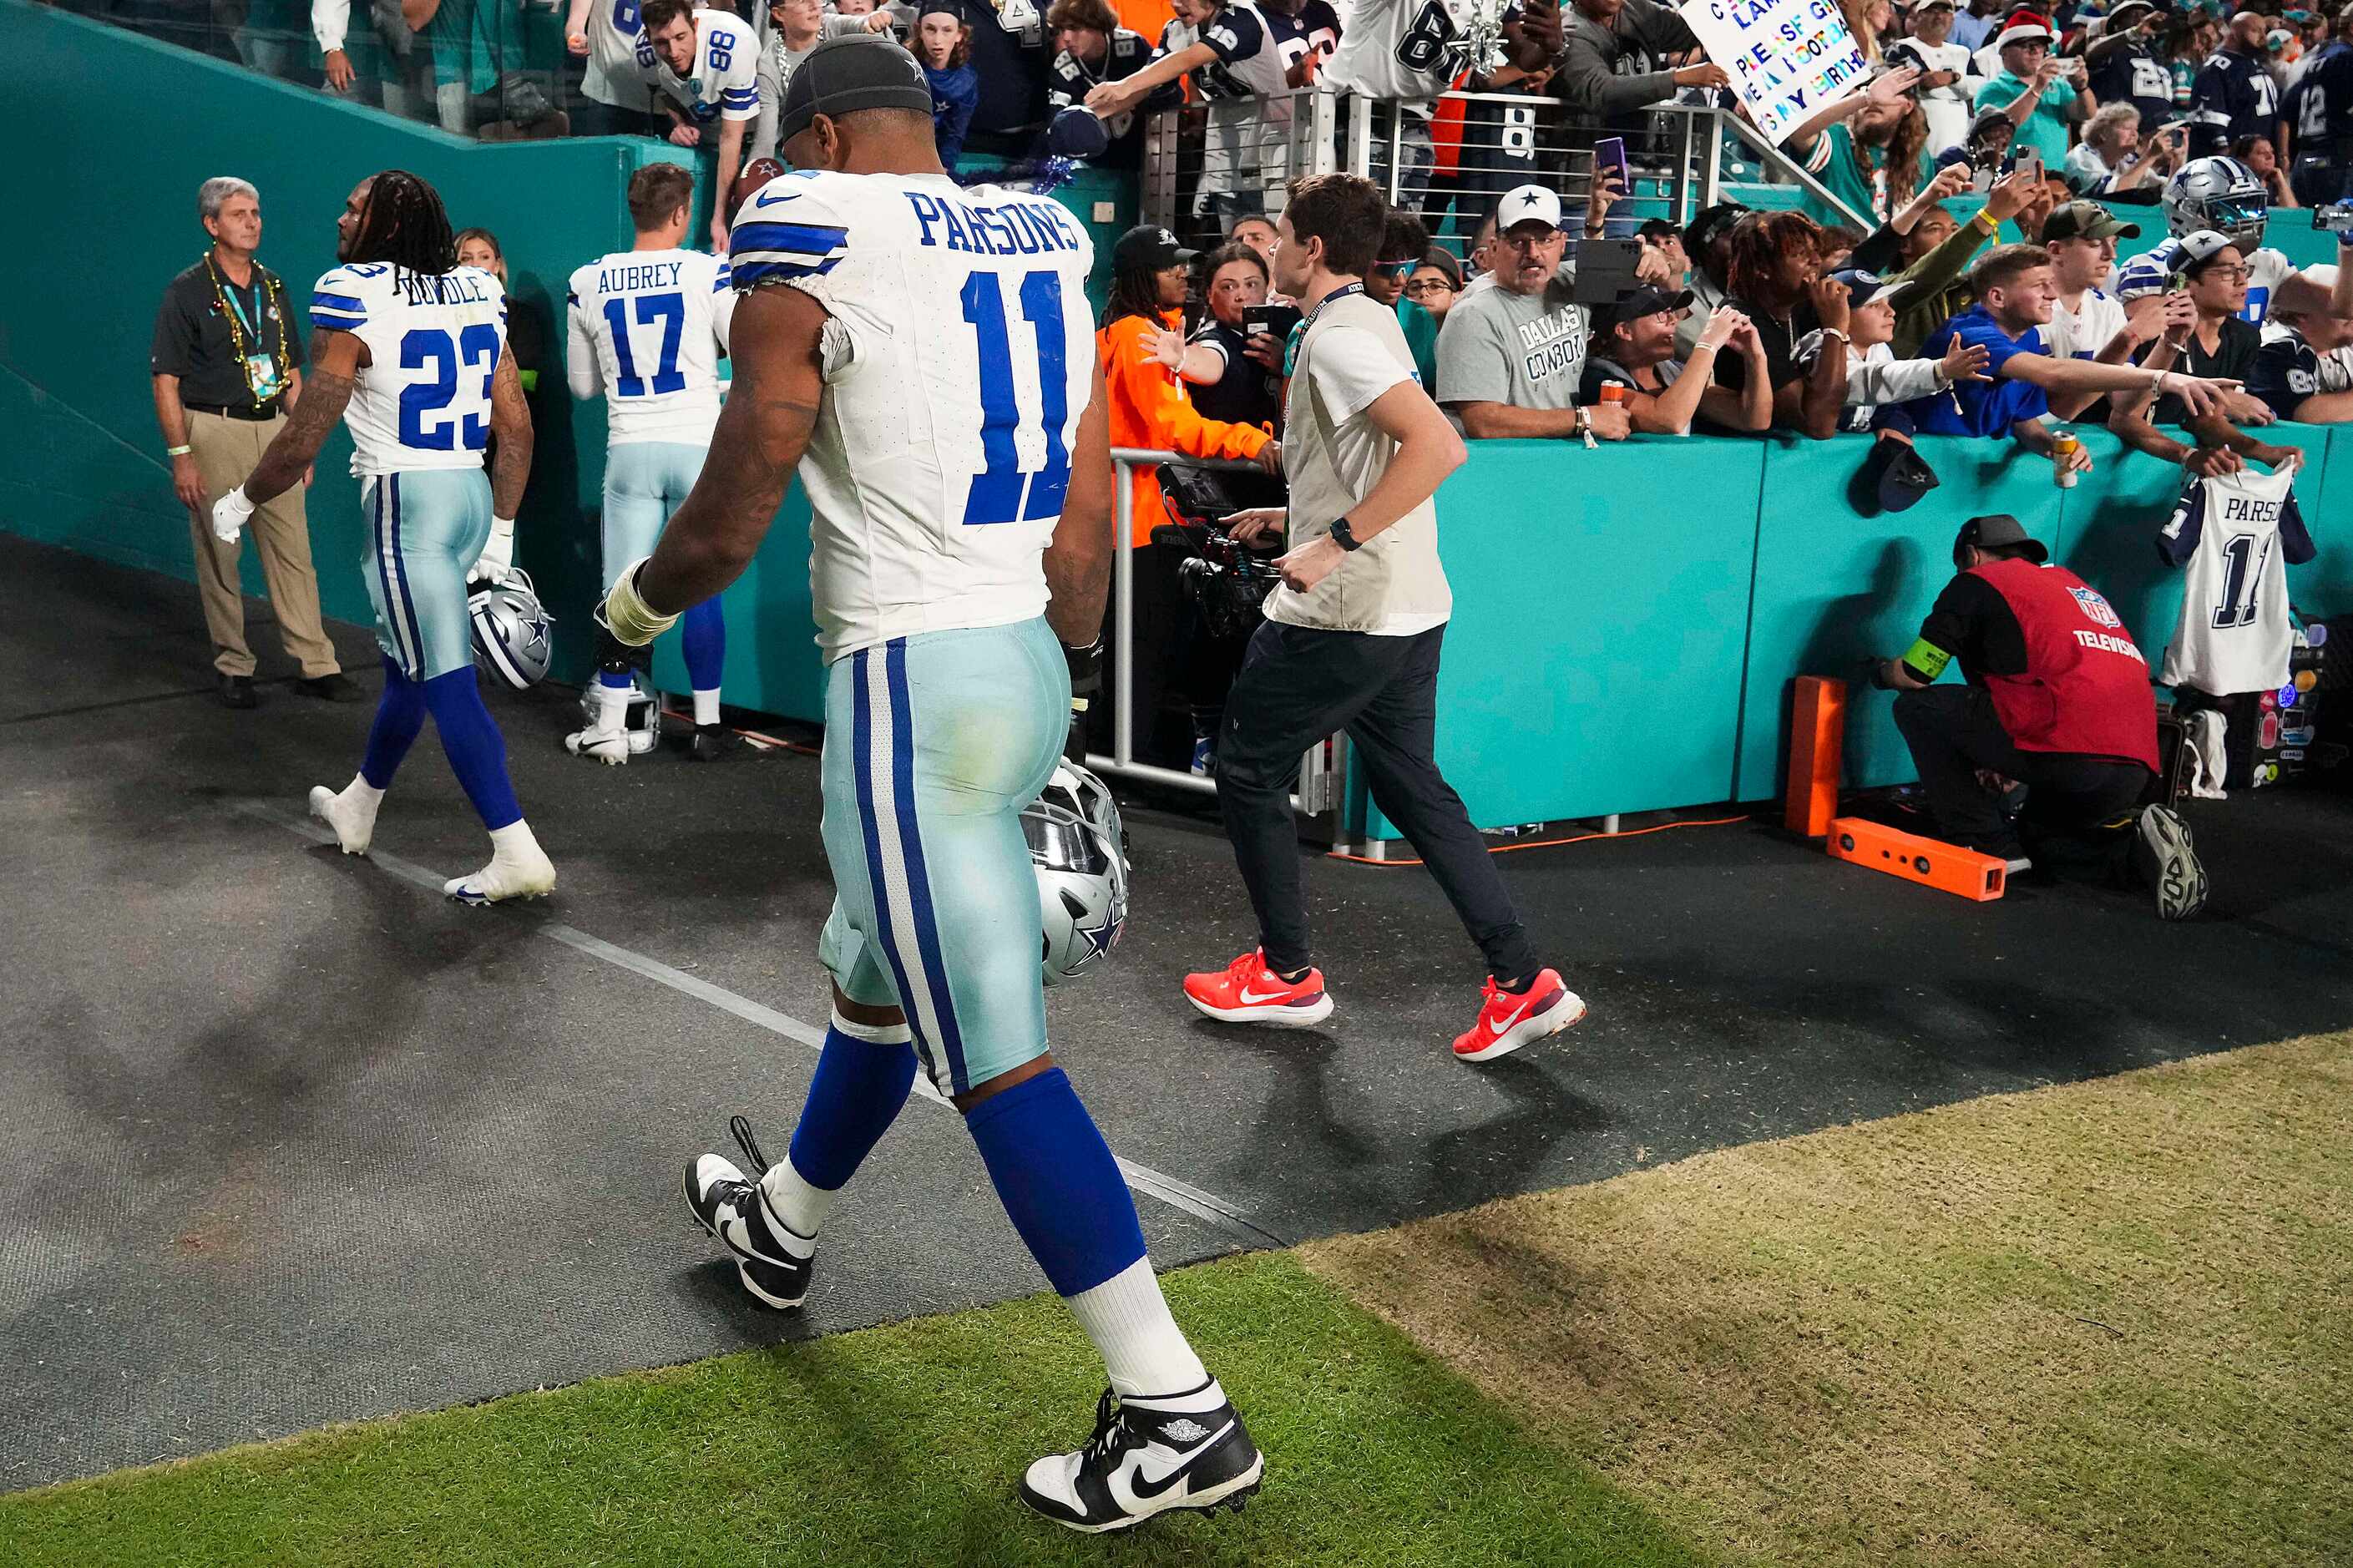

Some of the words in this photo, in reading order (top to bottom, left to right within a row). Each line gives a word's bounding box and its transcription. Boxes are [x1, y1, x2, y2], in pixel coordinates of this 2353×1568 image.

[709, 30, 736, 72] 88
[903, 191, 1079, 255] PARSONS
[598, 261, 683, 294] AUBREY
[603, 292, 686, 397] 17
[1304, 299, 1328, 330] STADIUM
[398, 323, 500, 451] 23
[960, 270, 1071, 525] 11
